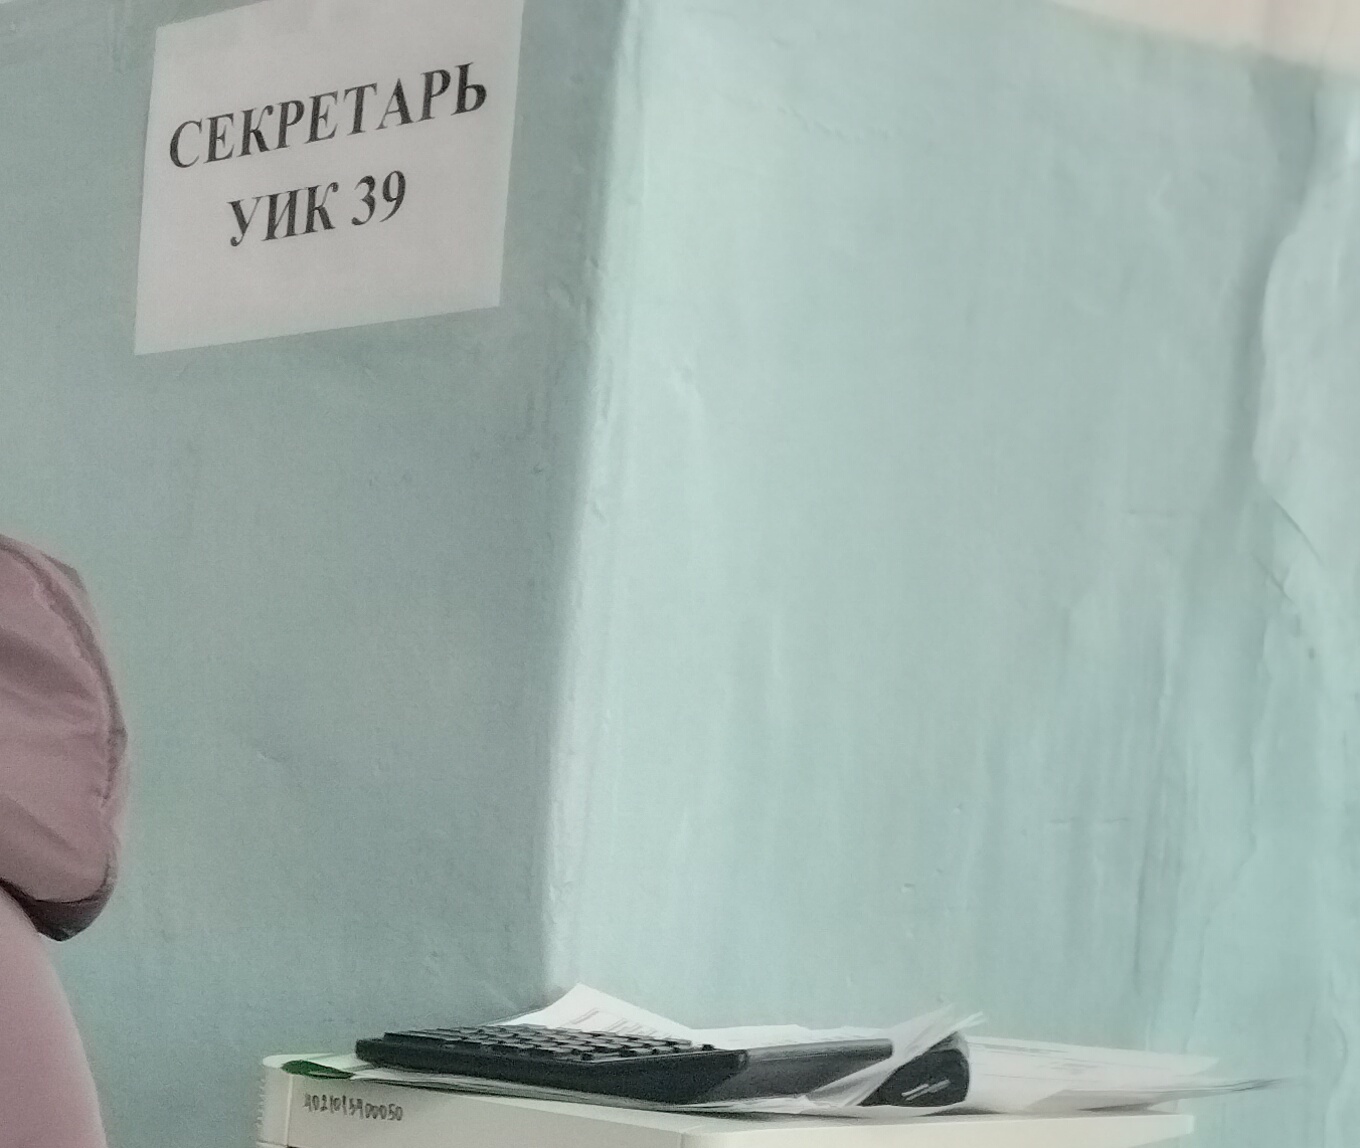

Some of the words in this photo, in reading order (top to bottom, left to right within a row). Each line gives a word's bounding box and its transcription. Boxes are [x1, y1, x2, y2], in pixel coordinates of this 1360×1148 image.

[169, 62, 487, 169] СЕКРЕТАРЬ
[227, 181, 340, 248] УИК
[351, 170, 407, 228] 39
